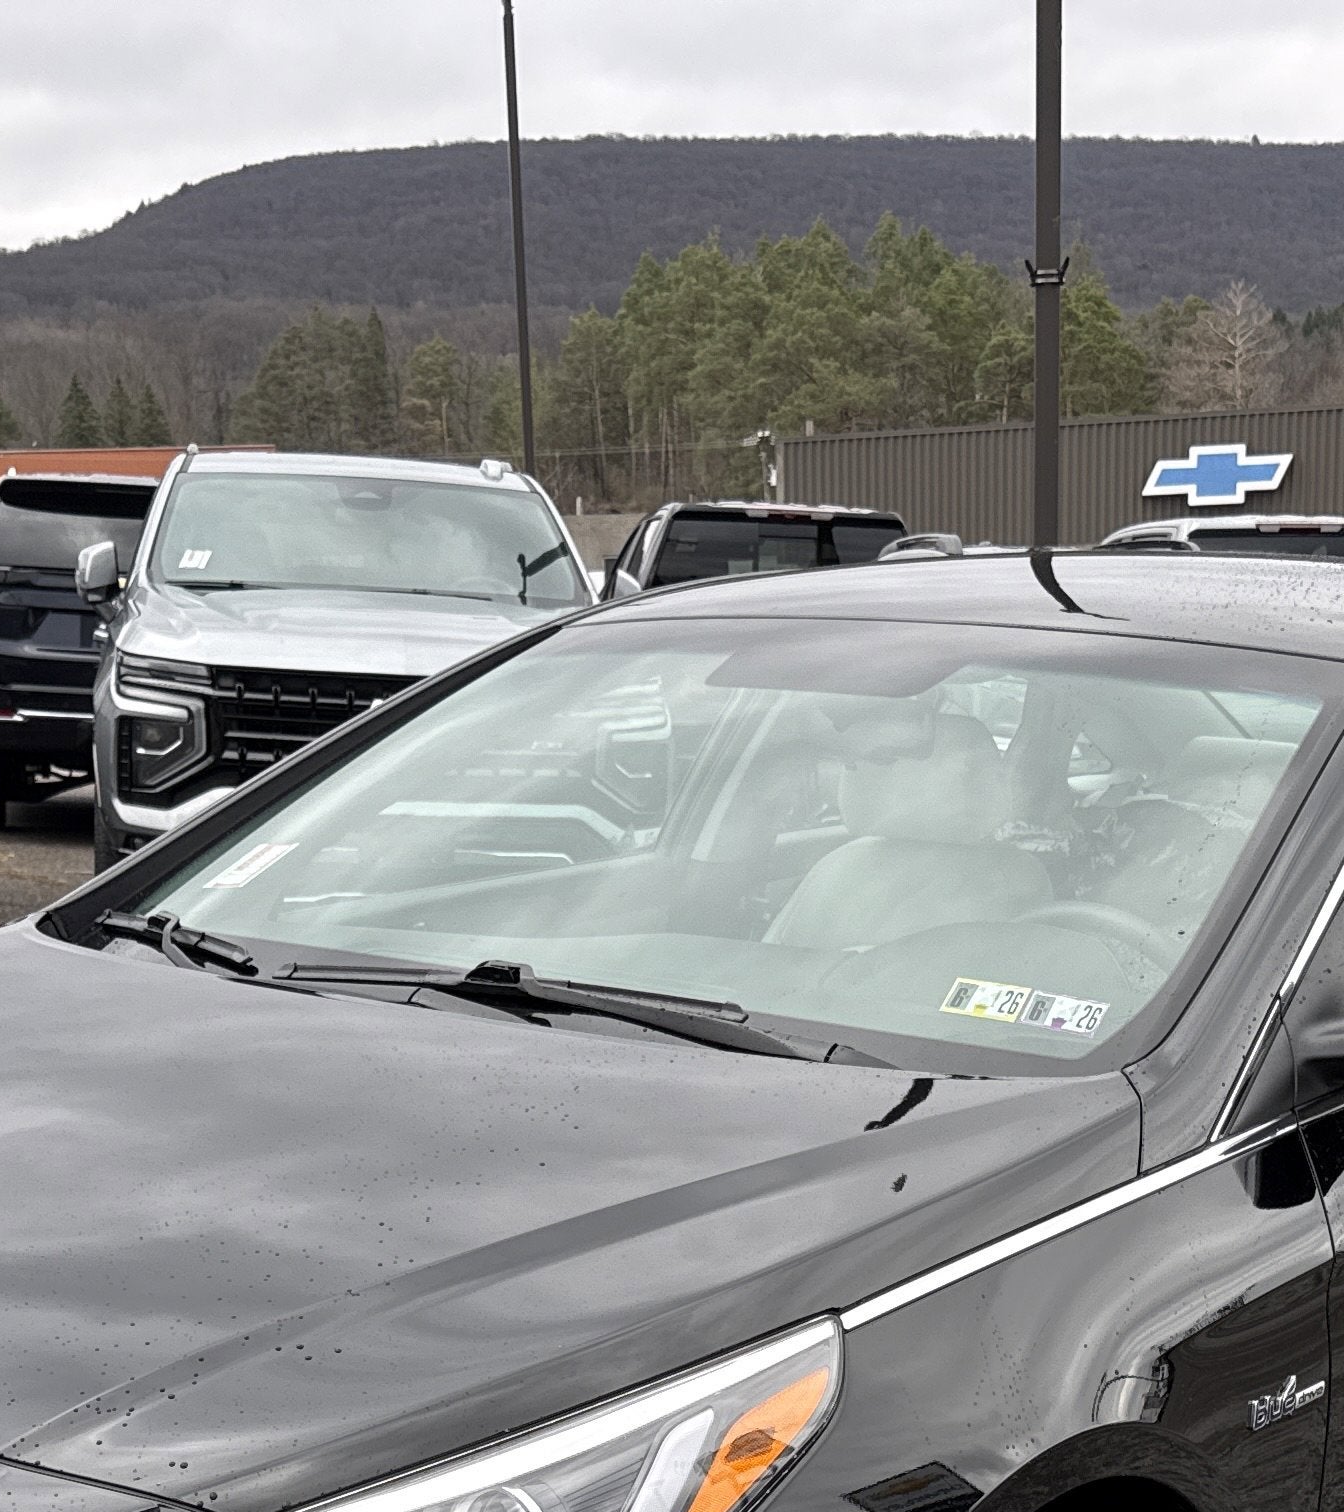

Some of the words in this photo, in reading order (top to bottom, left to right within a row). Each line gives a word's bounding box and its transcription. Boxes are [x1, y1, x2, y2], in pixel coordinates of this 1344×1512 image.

[950, 988, 968, 1007] 6
[997, 990, 1024, 1014] 26
[1029, 1000, 1046, 1021] 6
[1076, 1005, 1102, 1030] 26
